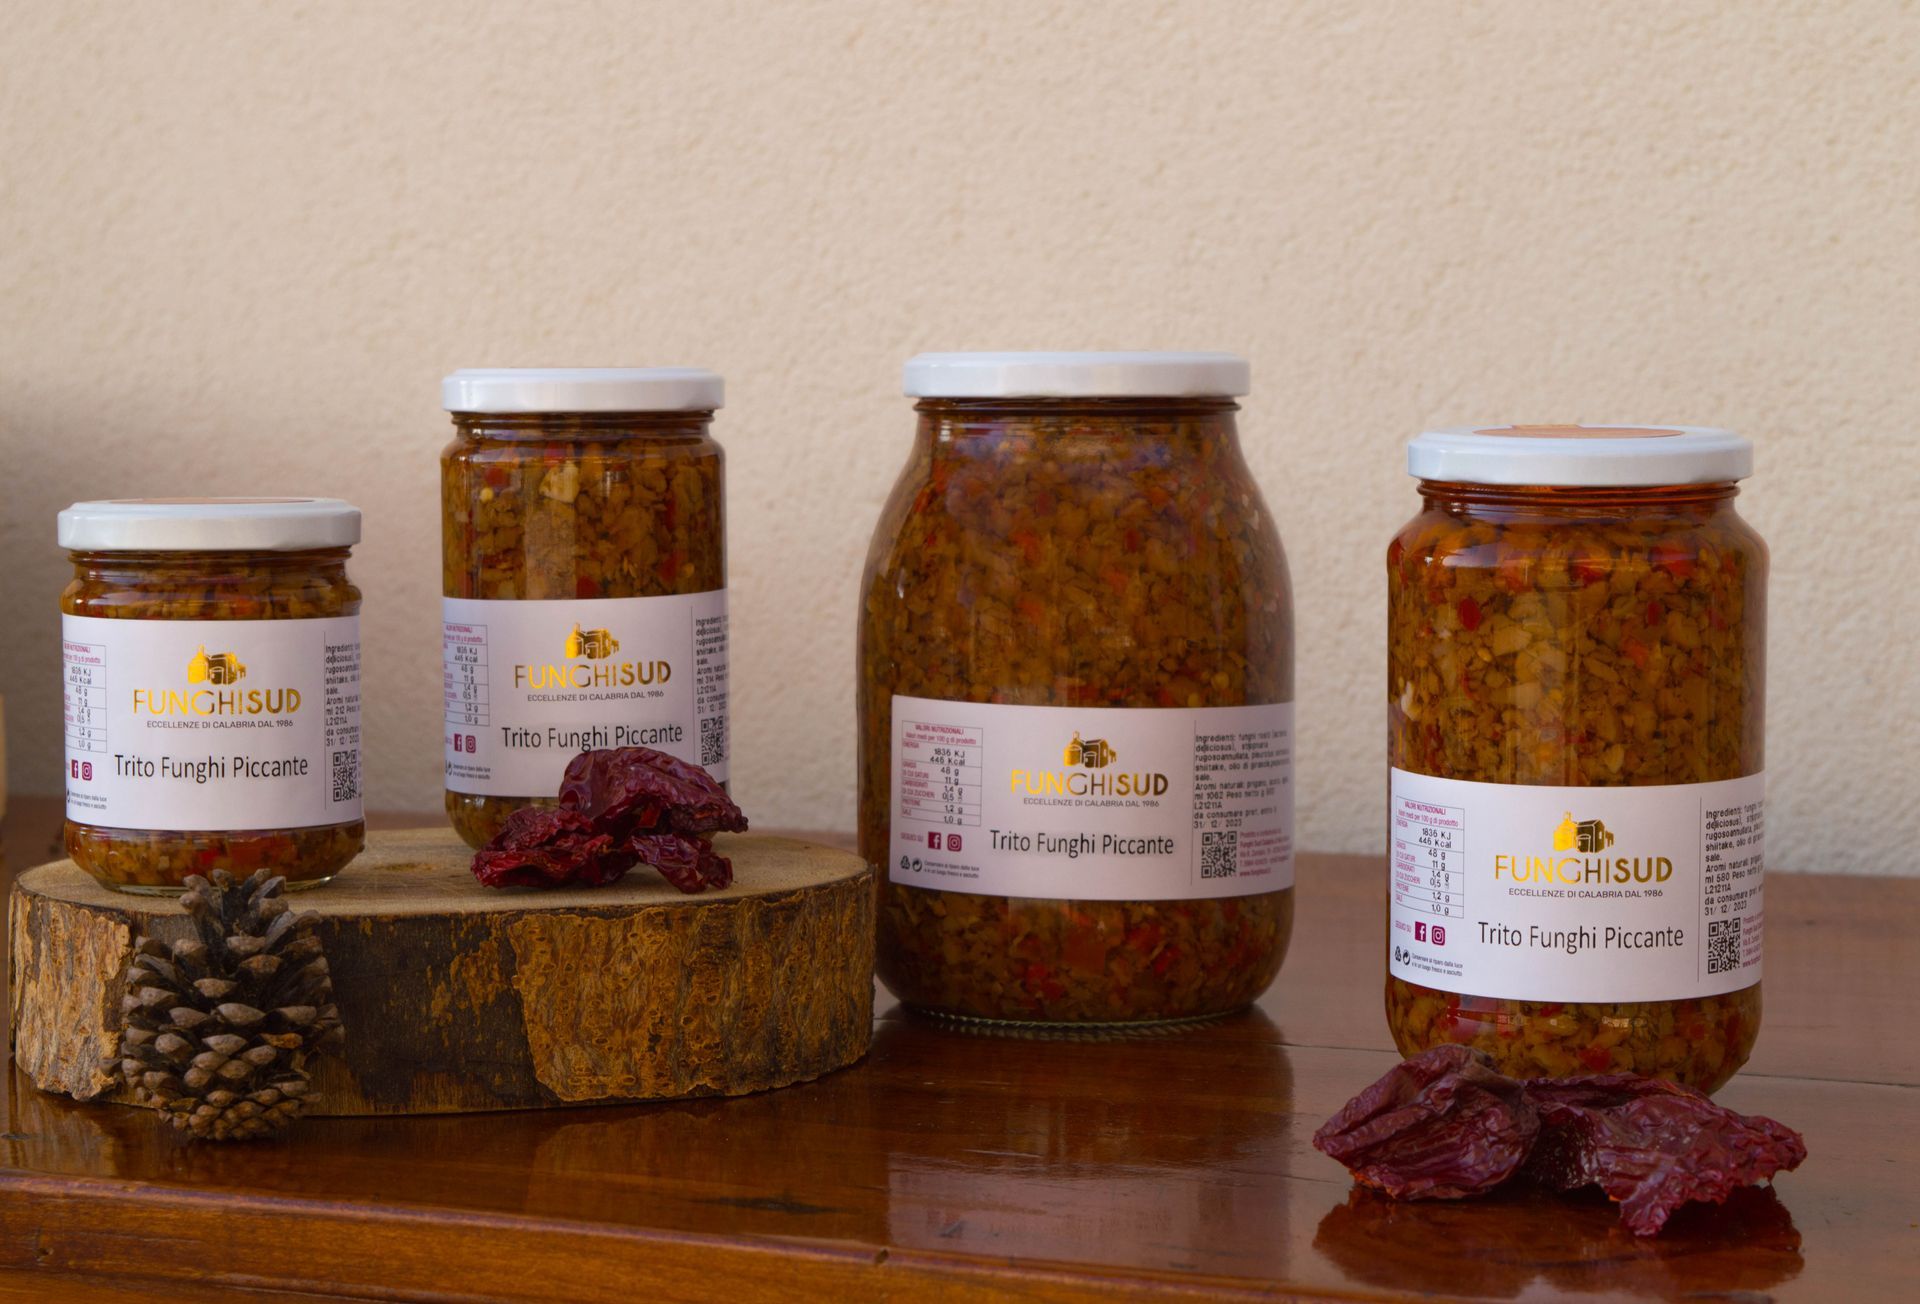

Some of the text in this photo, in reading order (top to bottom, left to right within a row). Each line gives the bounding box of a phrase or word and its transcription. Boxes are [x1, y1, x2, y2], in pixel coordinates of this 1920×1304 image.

[515, 661, 671, 688] FUNGHISUD
[528, 690, 664, 702] ECCELLENZE DI CALABRIA DAL 1986
[133, 688, 301, 716] FUNGHISUD
[147, 719, 294, 729] ECCELLENZE DI CALABRIA DAL 1986
[501, 724, 683, 752] Trito Funghi Piccante
[954, 749, 966, 759] KJ
[948, 757, 966, 767] Kcal
[115, 754, 309, 784] Trito Funghi Piccante
[941, 766, 960, 777] 48 g
[954, 778, 960, 786] g
[1011, 769, 1168, 796] FUNGHISUD
[1195, 783, 1217, 791] Aromi
[1195, 791, 1204, 800] ml
[1023, 797, 1159, 808] ECCELLENZE DI CALABRIA DAL 1986
[1194, 811, 1204, 820] da
[1440, 831, 1452, 841] KJ
[990, 829, 1174, 859] Trito Funghi Piccante
[1434, 839, 1452, 849] Kcal
[1428, 848, 1446, 861] 48 g
[1440, 862, 1446, 872] g
[1495, 854, 1673, 884] FUNGHISUD
[1705, 862, 1727, 873] Aromi
[1430, 877, 1442, 888] 0,5
[1705, 874, 1714, 884] ml
[1716, 871, 1730, 883] 580
[1432, 891, 1450, 904] 1,2 g
[1509, 887, 1663, 899] ECCELLENZE DI CALABRIA DAL 1986
[1705, 896, 1714, 906] da
[1432, 903, 1450, 916] 1,0 g
[1478, 921, 1684, 955] Trito Funghi Piccante
